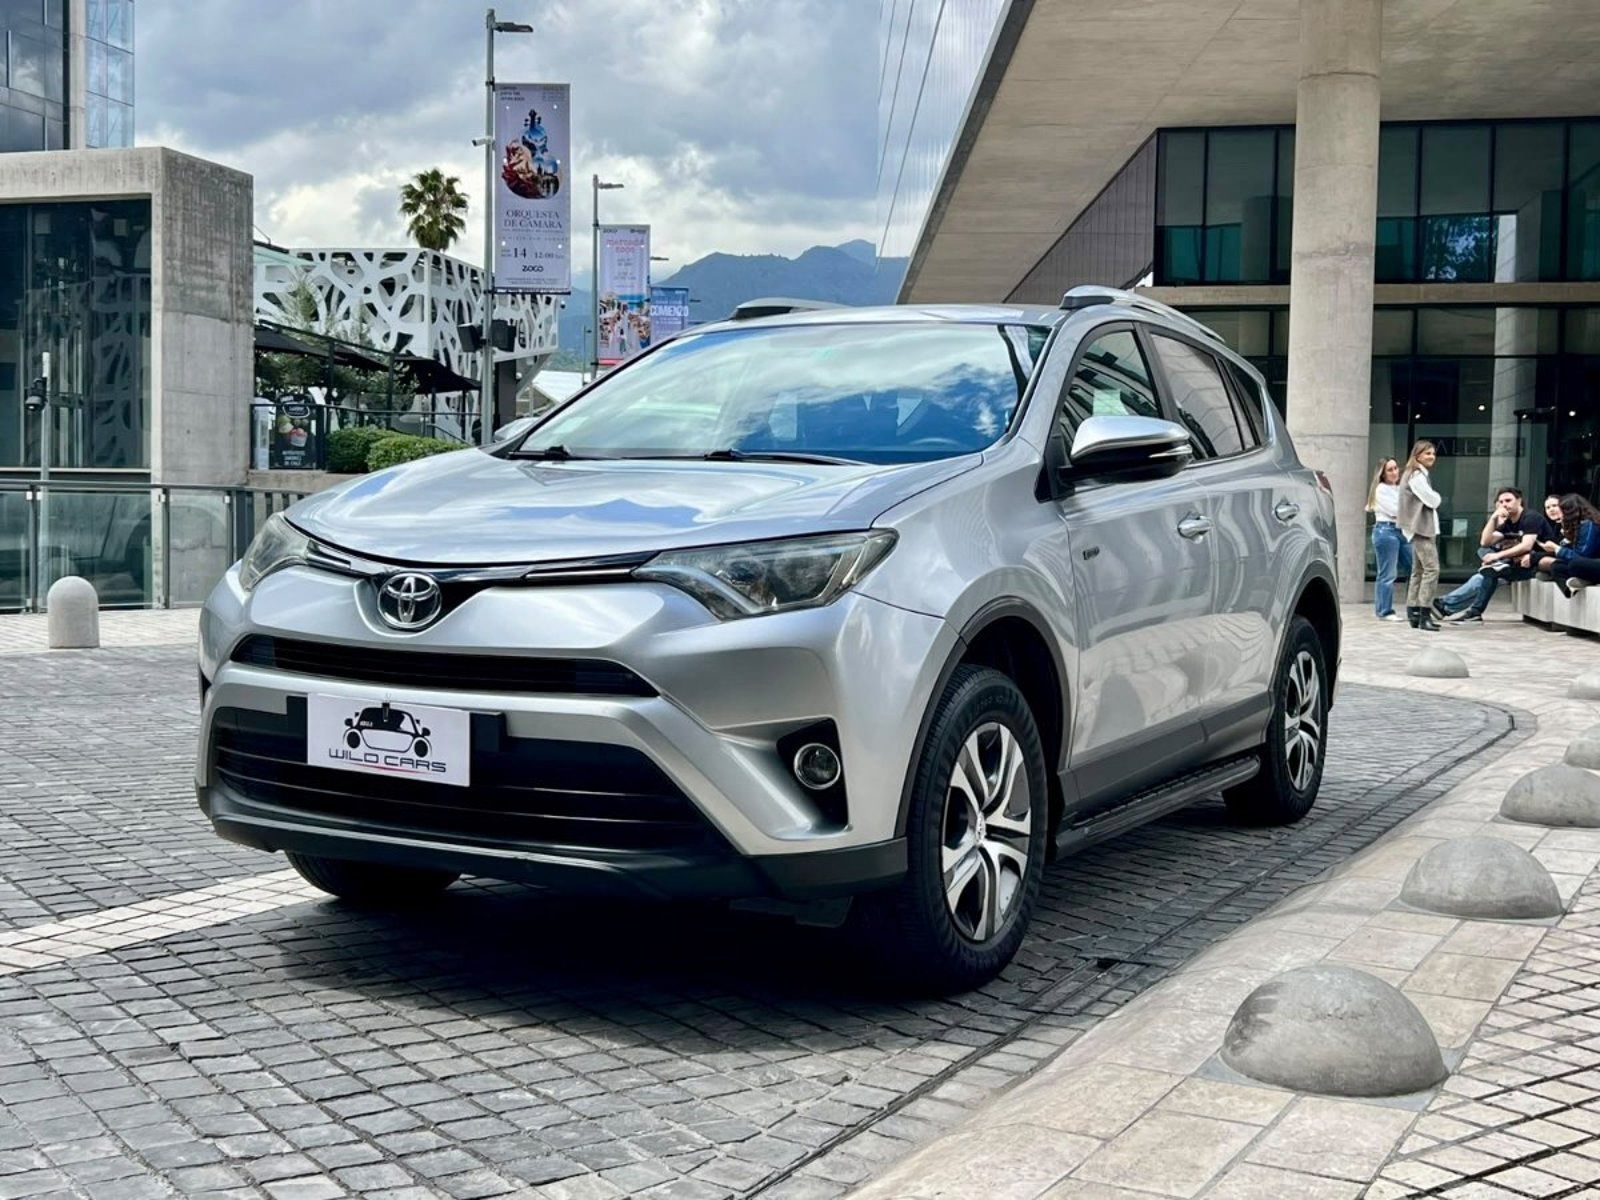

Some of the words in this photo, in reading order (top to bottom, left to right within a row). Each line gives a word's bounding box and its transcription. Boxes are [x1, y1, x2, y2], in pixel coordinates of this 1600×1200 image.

[506, 209, 560, 219] ORQUESTA
[503, 219, 518, 227] DE
[513, 247, 527, 259] 14
[328, 748, 379, 764] WILD
[384, 755, 447, 773] CARS
